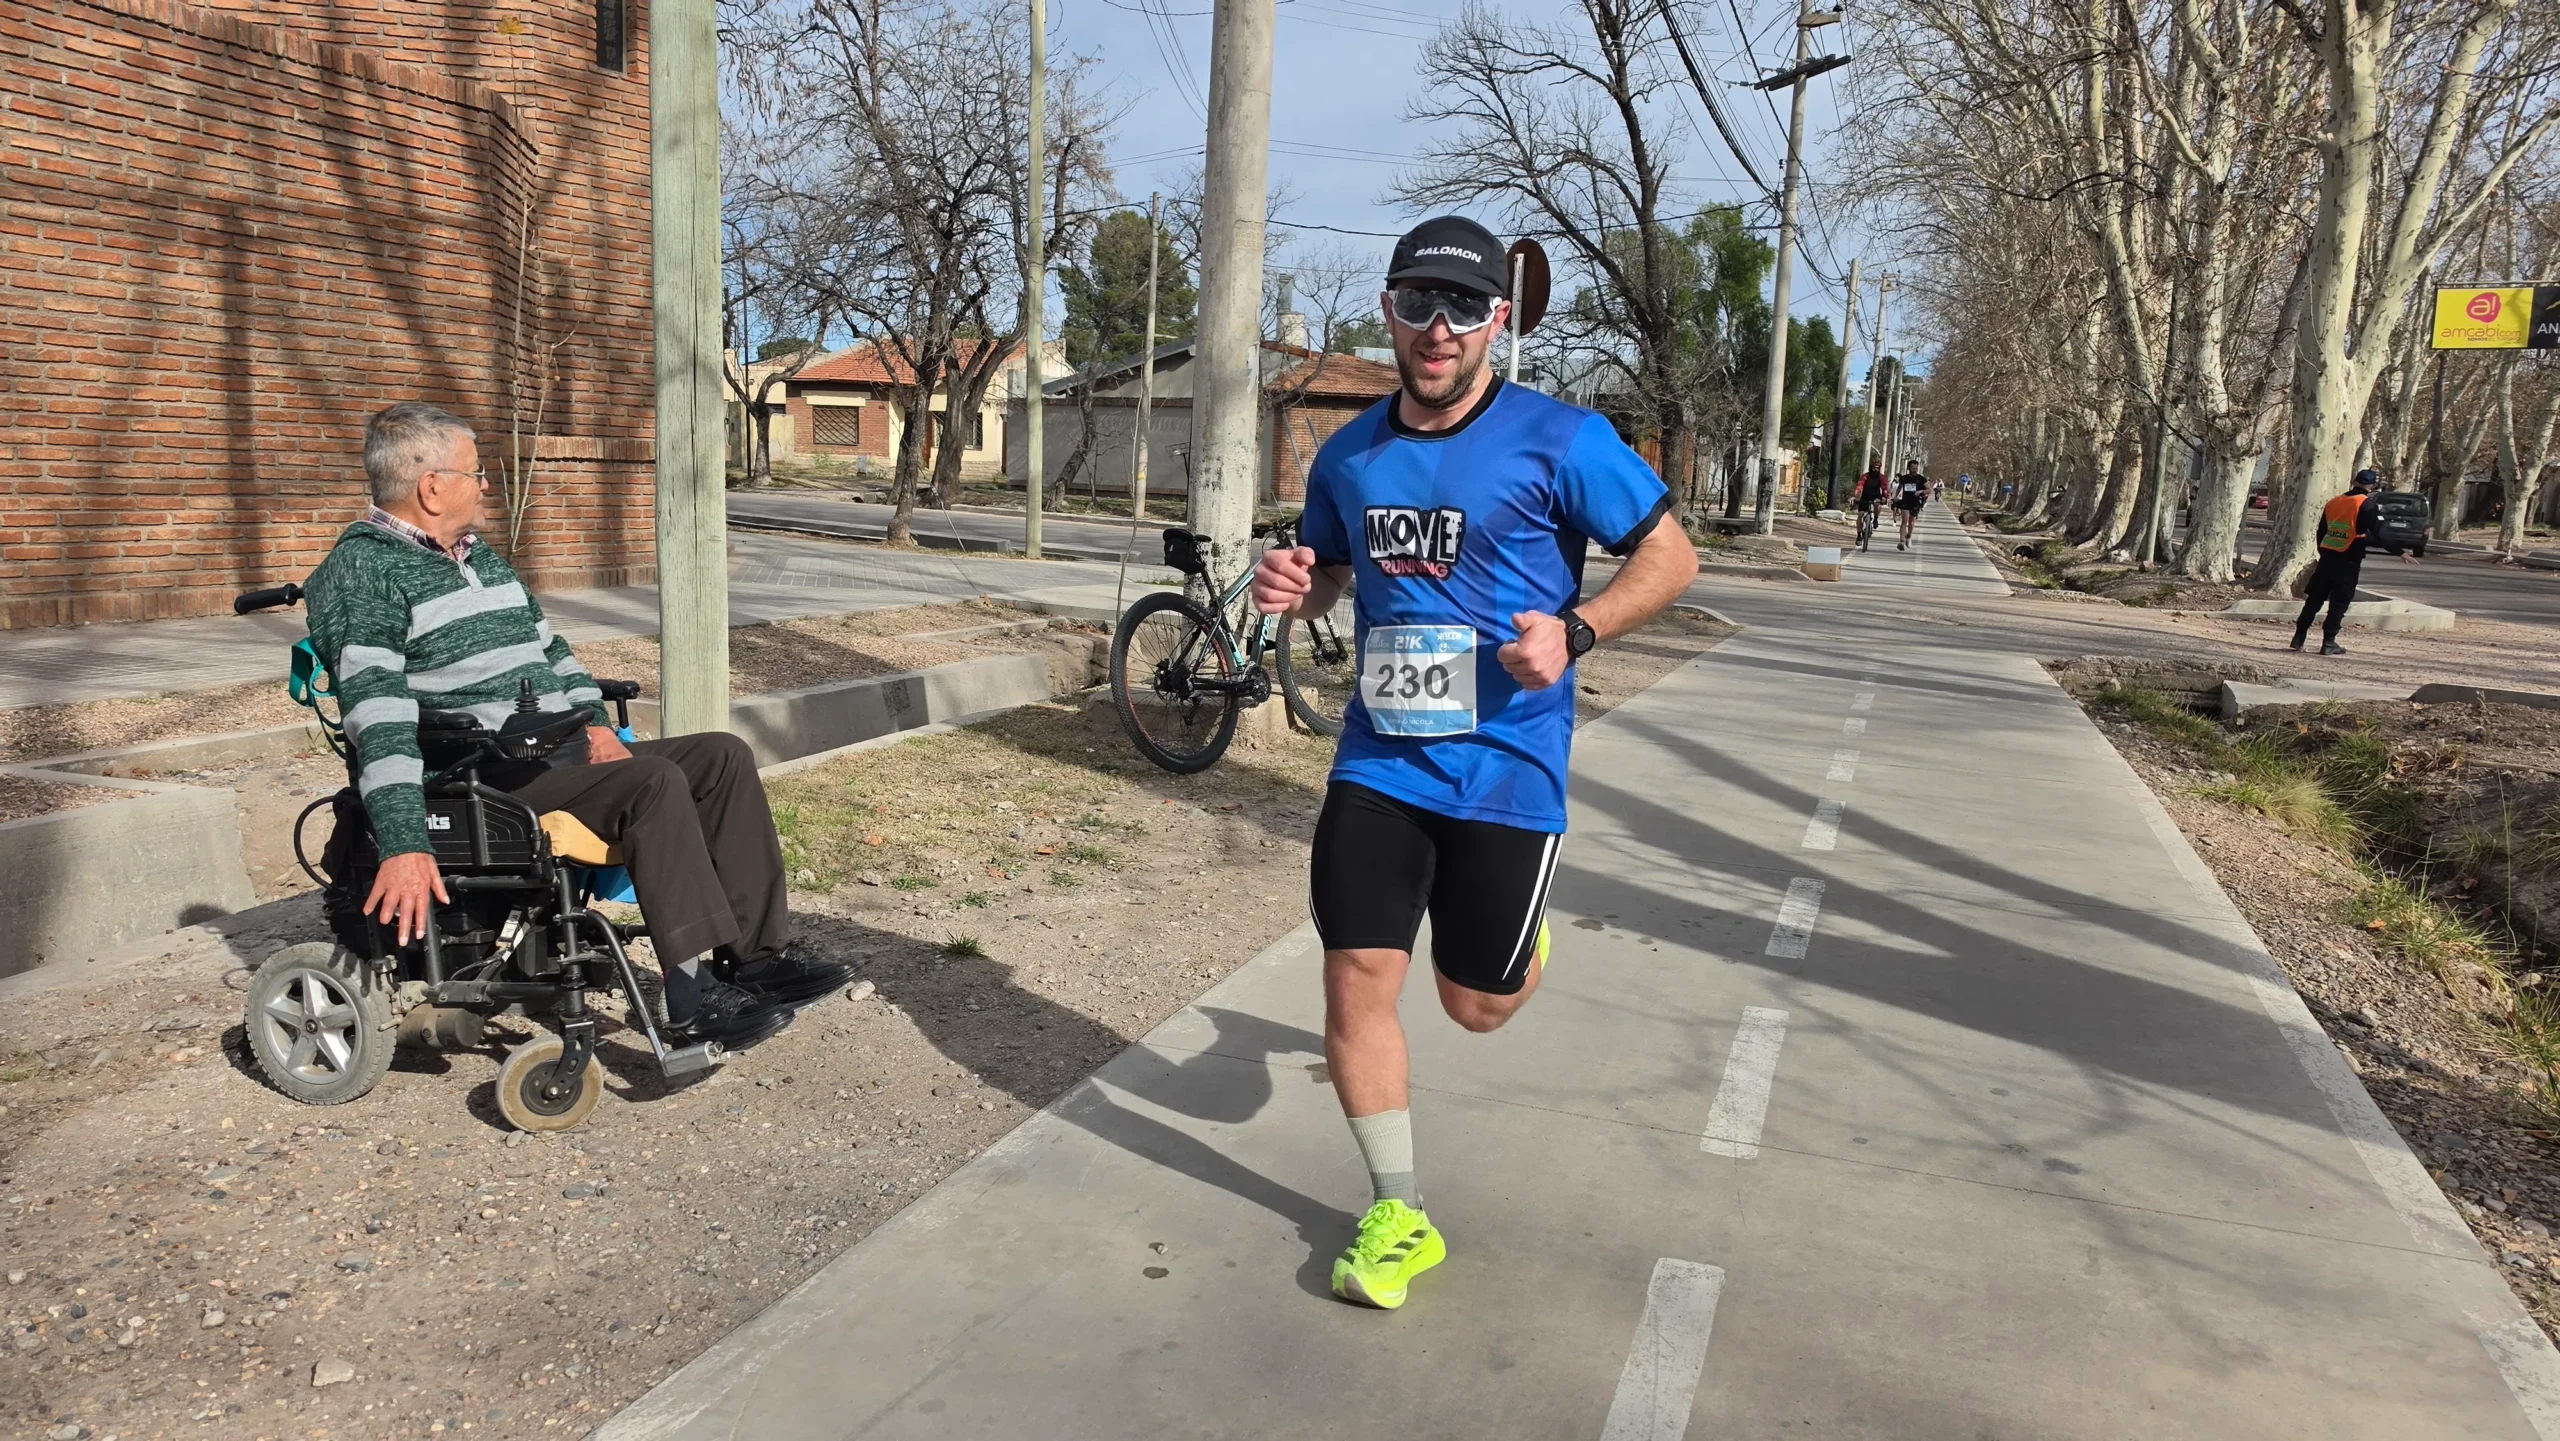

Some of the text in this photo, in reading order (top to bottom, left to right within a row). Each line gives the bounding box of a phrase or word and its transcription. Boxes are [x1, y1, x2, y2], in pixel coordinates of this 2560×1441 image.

[1415, 246, 1482, 263] SALOMON
[1368, 509, 1462, 562] MOVE
[1381, 560, 1448, 578] RUNNING
[1375, 664, 1450, 700] 230
